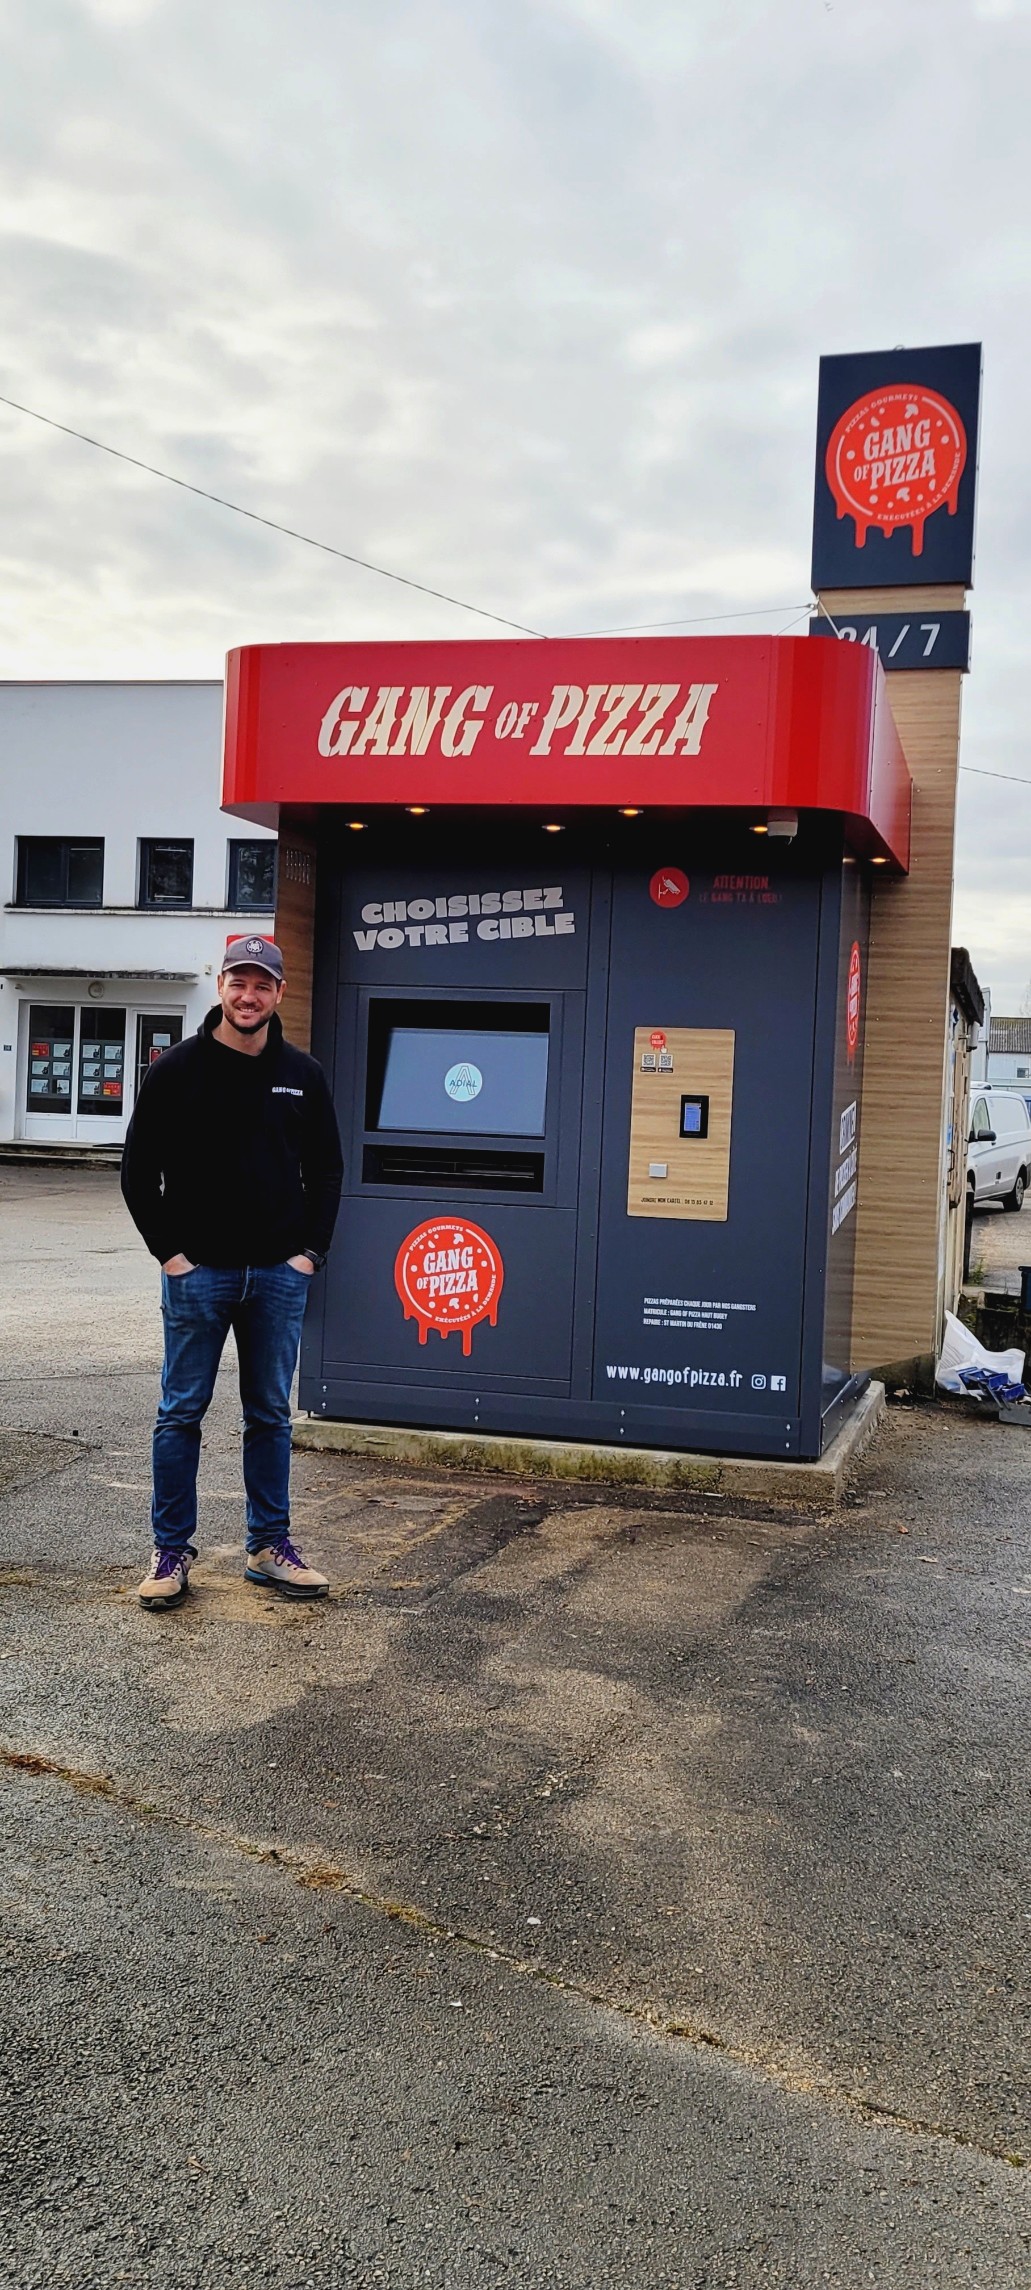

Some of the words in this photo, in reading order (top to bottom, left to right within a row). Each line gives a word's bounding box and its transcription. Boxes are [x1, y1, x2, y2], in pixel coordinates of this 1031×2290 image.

[863, 418, 931, 461] GANG
[854, 464, 869, 482] OF
[870, 448, 936, 490] PIZZA
[317, 685, 495, 758] GANG
[494, 701, 539, 739] OF
[529, 683, 720, 756] PIZZA
[713, 875, 769, 890] ATTENTION
[361, 886, 564, 924] CHOISISSEZ
[353, 921, 469, 951] VOTRE
[477, 912, 575, 941] CIBLE
[450, 1079, 477, 1088] ADIAL
[409, 1231, 427, 1251] PIZZAS
[427, 1225, 464, 1234] GOURMETS
[423, 1246, 474, 1274] GANG
[416, 1277, 429, 1290] OF
[429, 1269, 479, 1298] PIZZA
[476, 1304, 484, 1313] LA
[483, 1274, 497, 1306] DEMANDE
[643, 1307, 668, 1316] MATRICULE
[669, 1309, 682, 1317] GANG
[644, 1297, 659, 1305] PIZZAS
[683, 1300, 701, 1308] CHAQUE
[730, 1303, 757, 1311] GANGSTERS
[669, 1319, 687, 1328] MARTIN
[686, 1320, 694, 1328] DU
[606, 1365, 743, 1388] www.gangofpizza.fr
